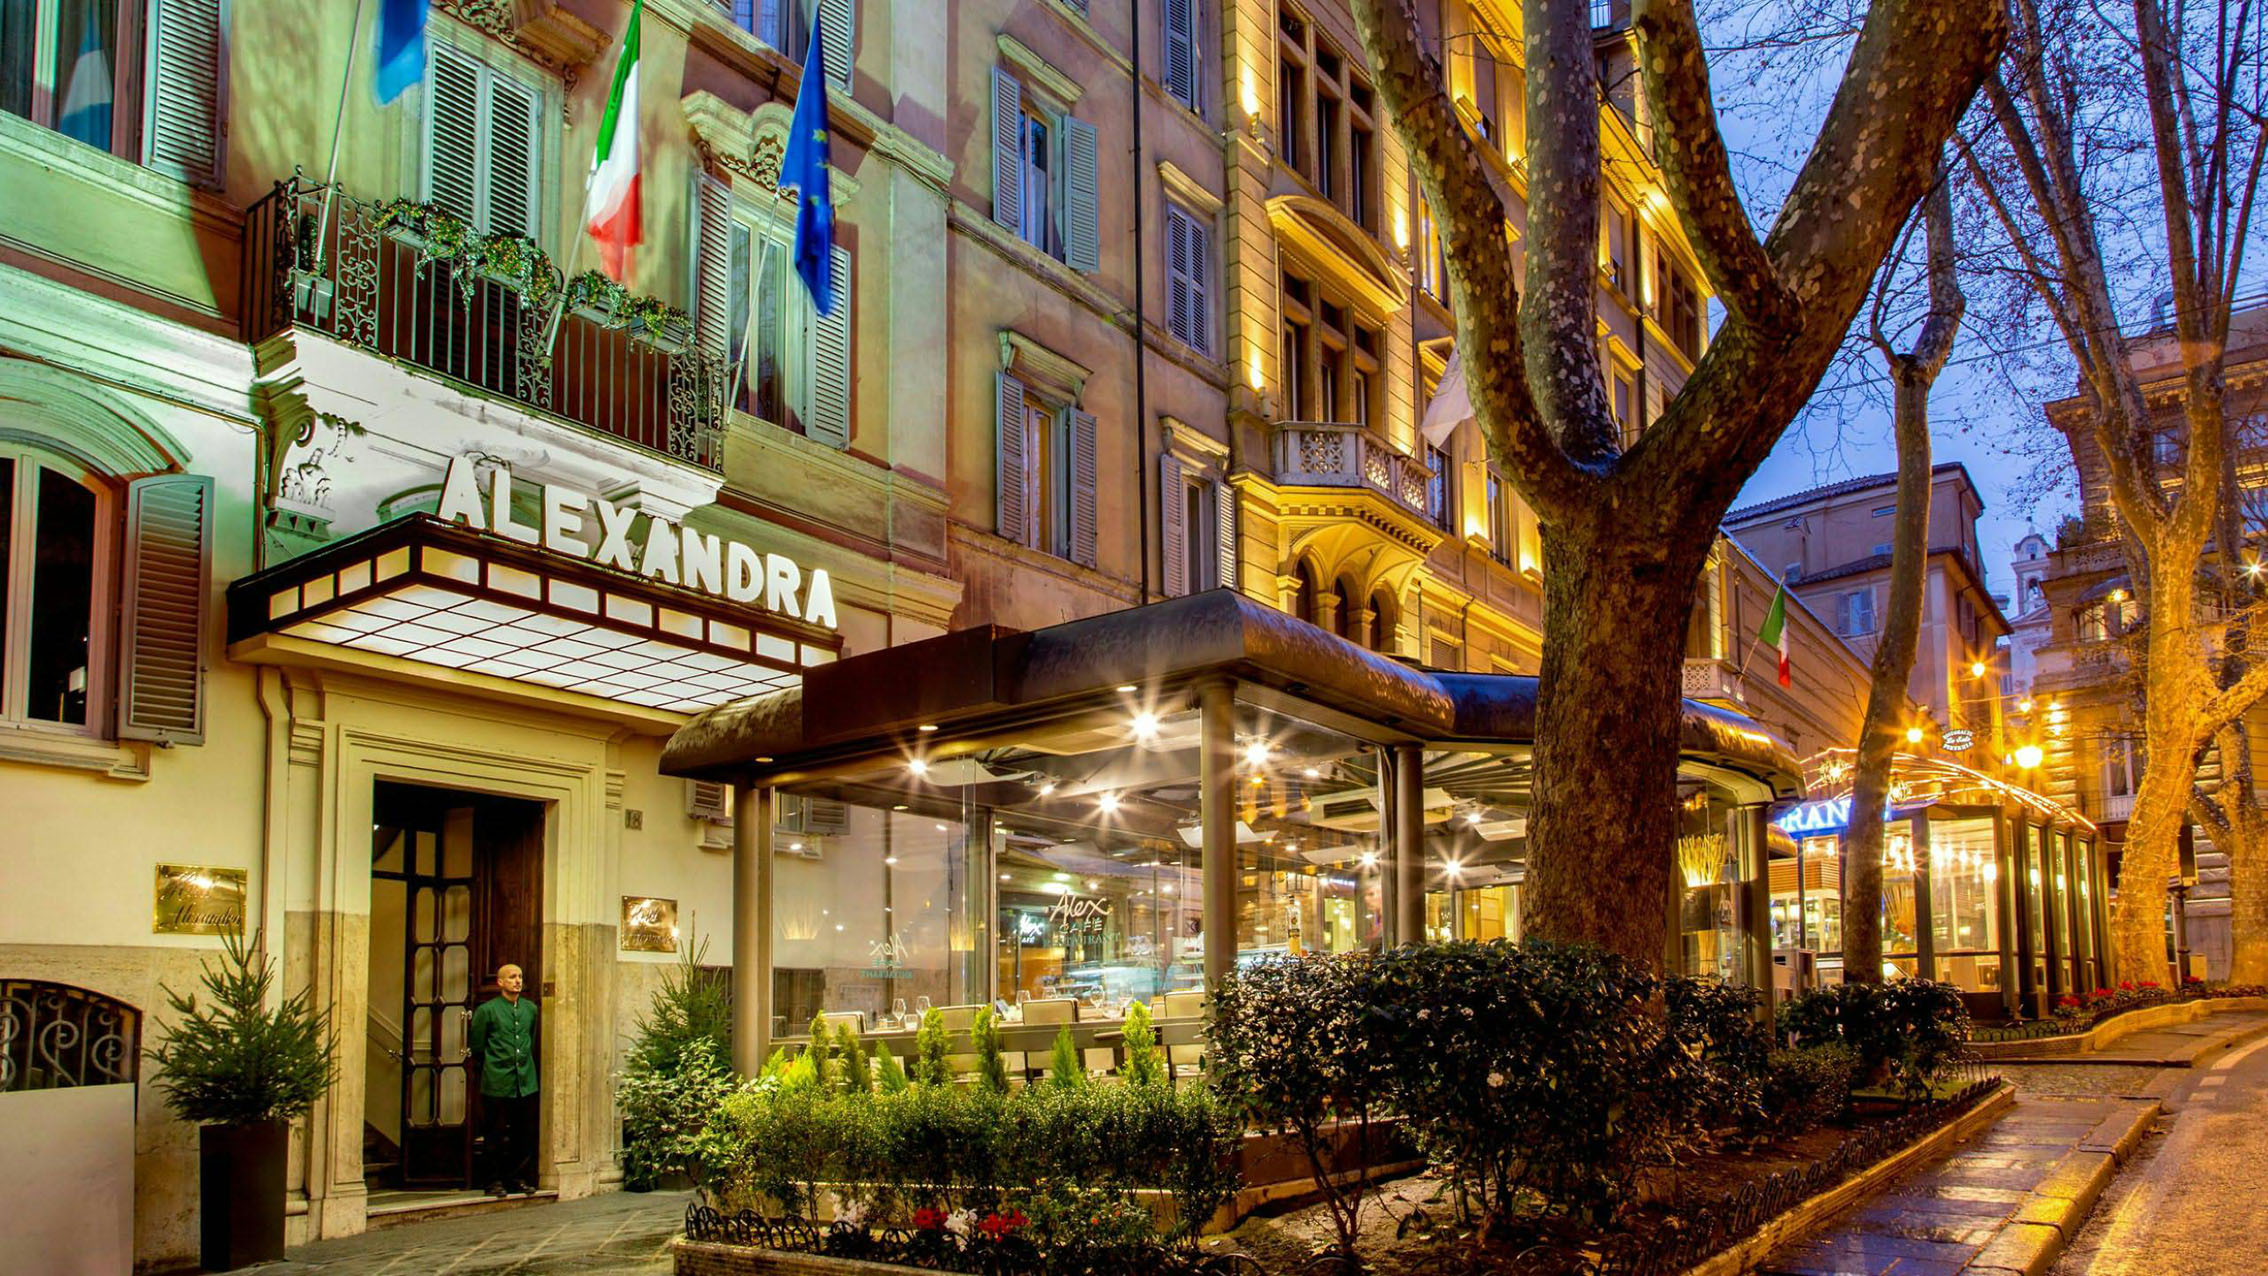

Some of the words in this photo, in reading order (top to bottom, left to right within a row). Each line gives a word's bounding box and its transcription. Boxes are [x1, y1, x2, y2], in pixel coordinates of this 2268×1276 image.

[438, 455, 837, 629] ALEXANDRA
[625, 809, 642, 830] 18
[1049, 889, 1111, 922] Alex
